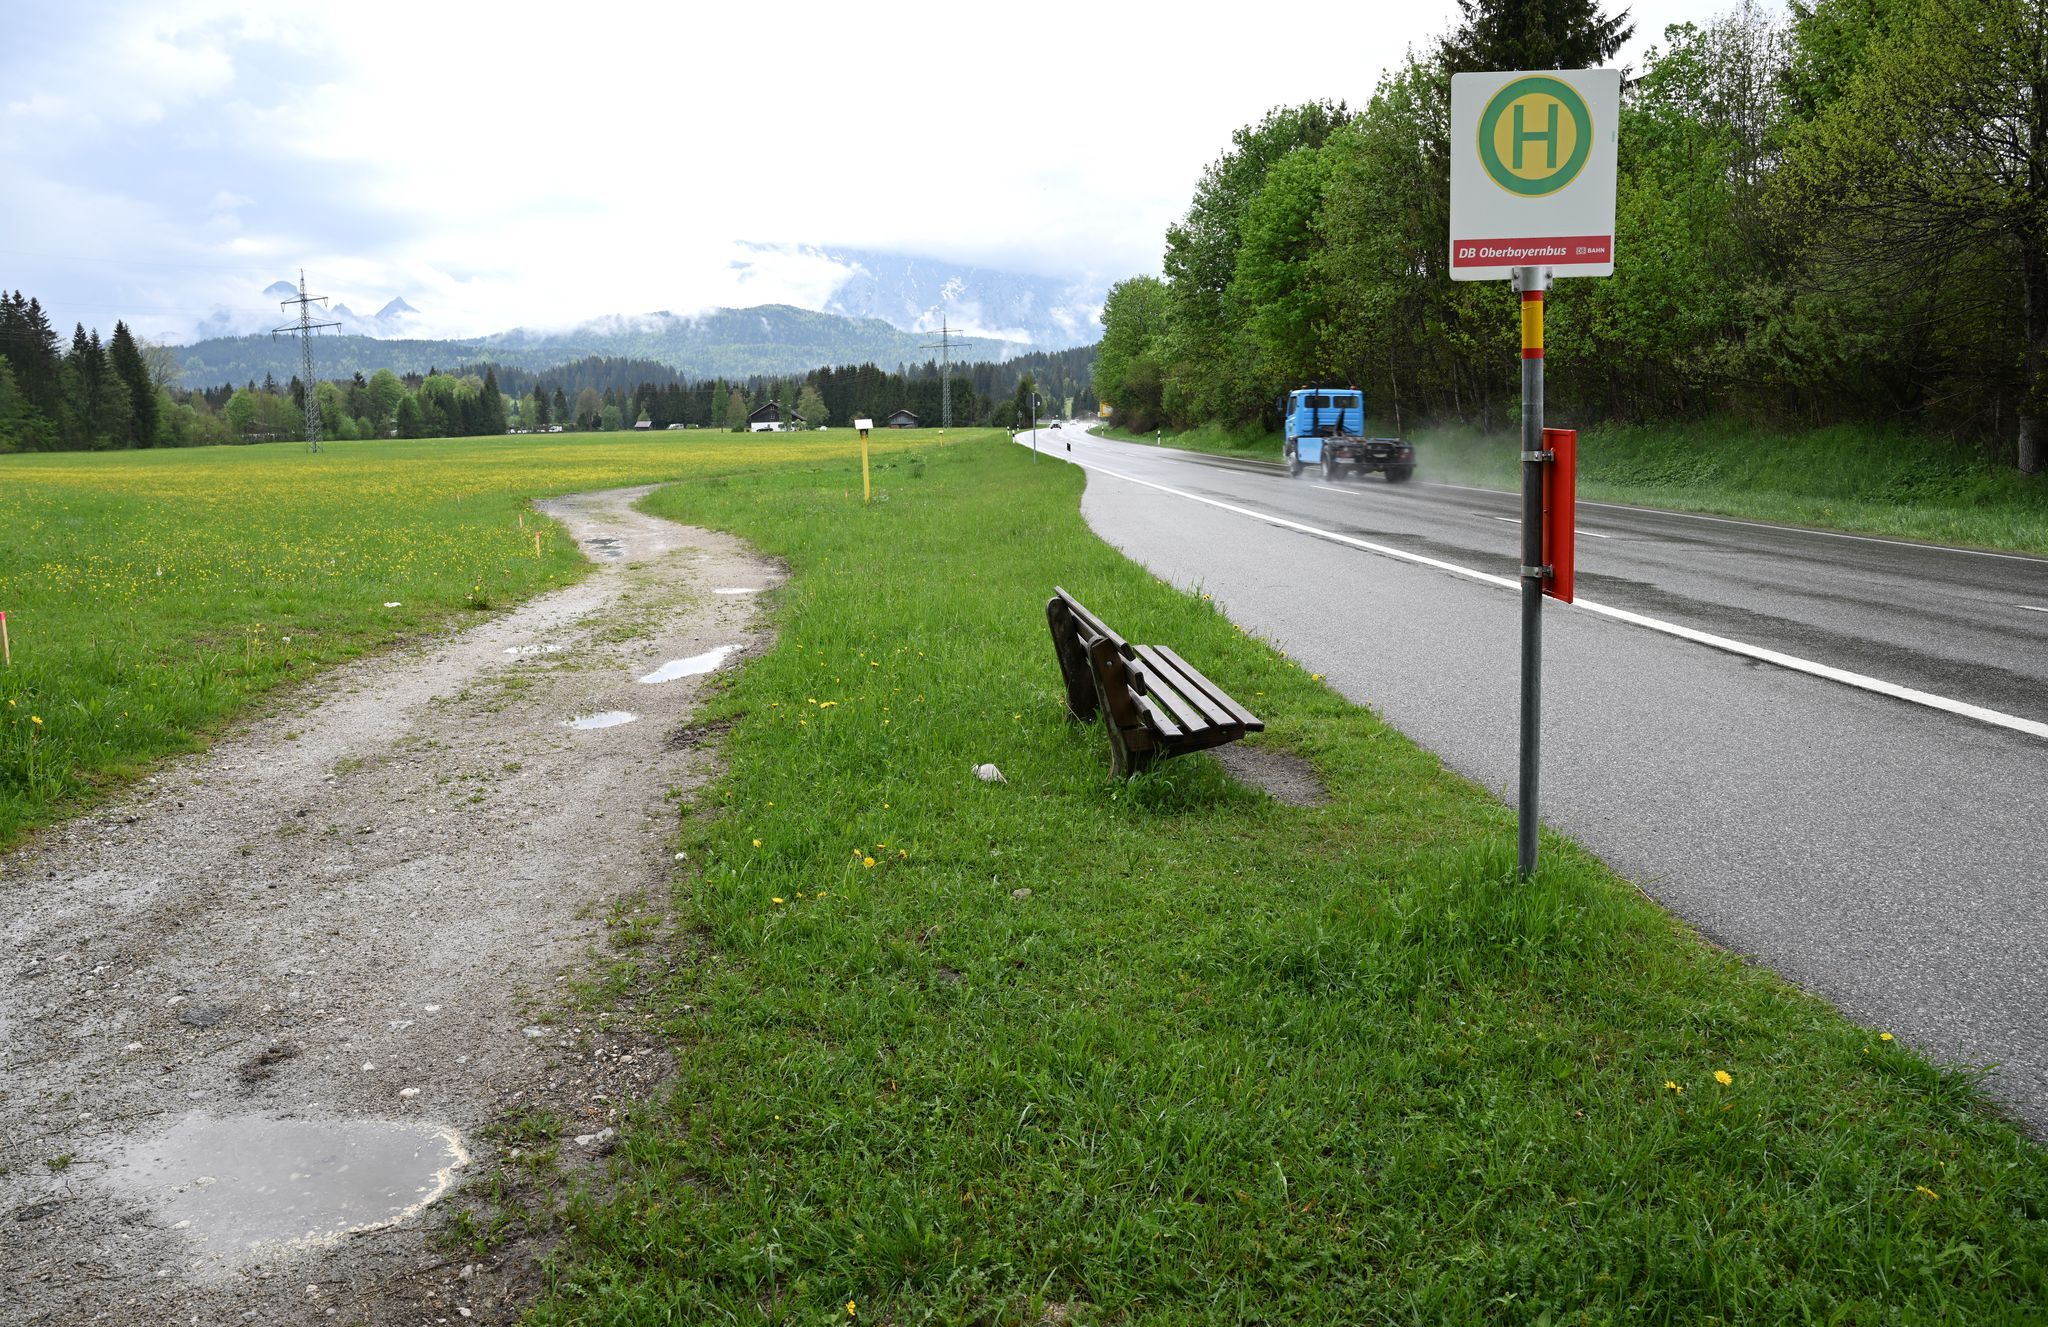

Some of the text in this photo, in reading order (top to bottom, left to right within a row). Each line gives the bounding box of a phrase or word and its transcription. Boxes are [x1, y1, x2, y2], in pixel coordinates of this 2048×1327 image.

[1512, 104, 1559, 169] H
[1459, 245, 1567, 259] DB Oberbayernbus
